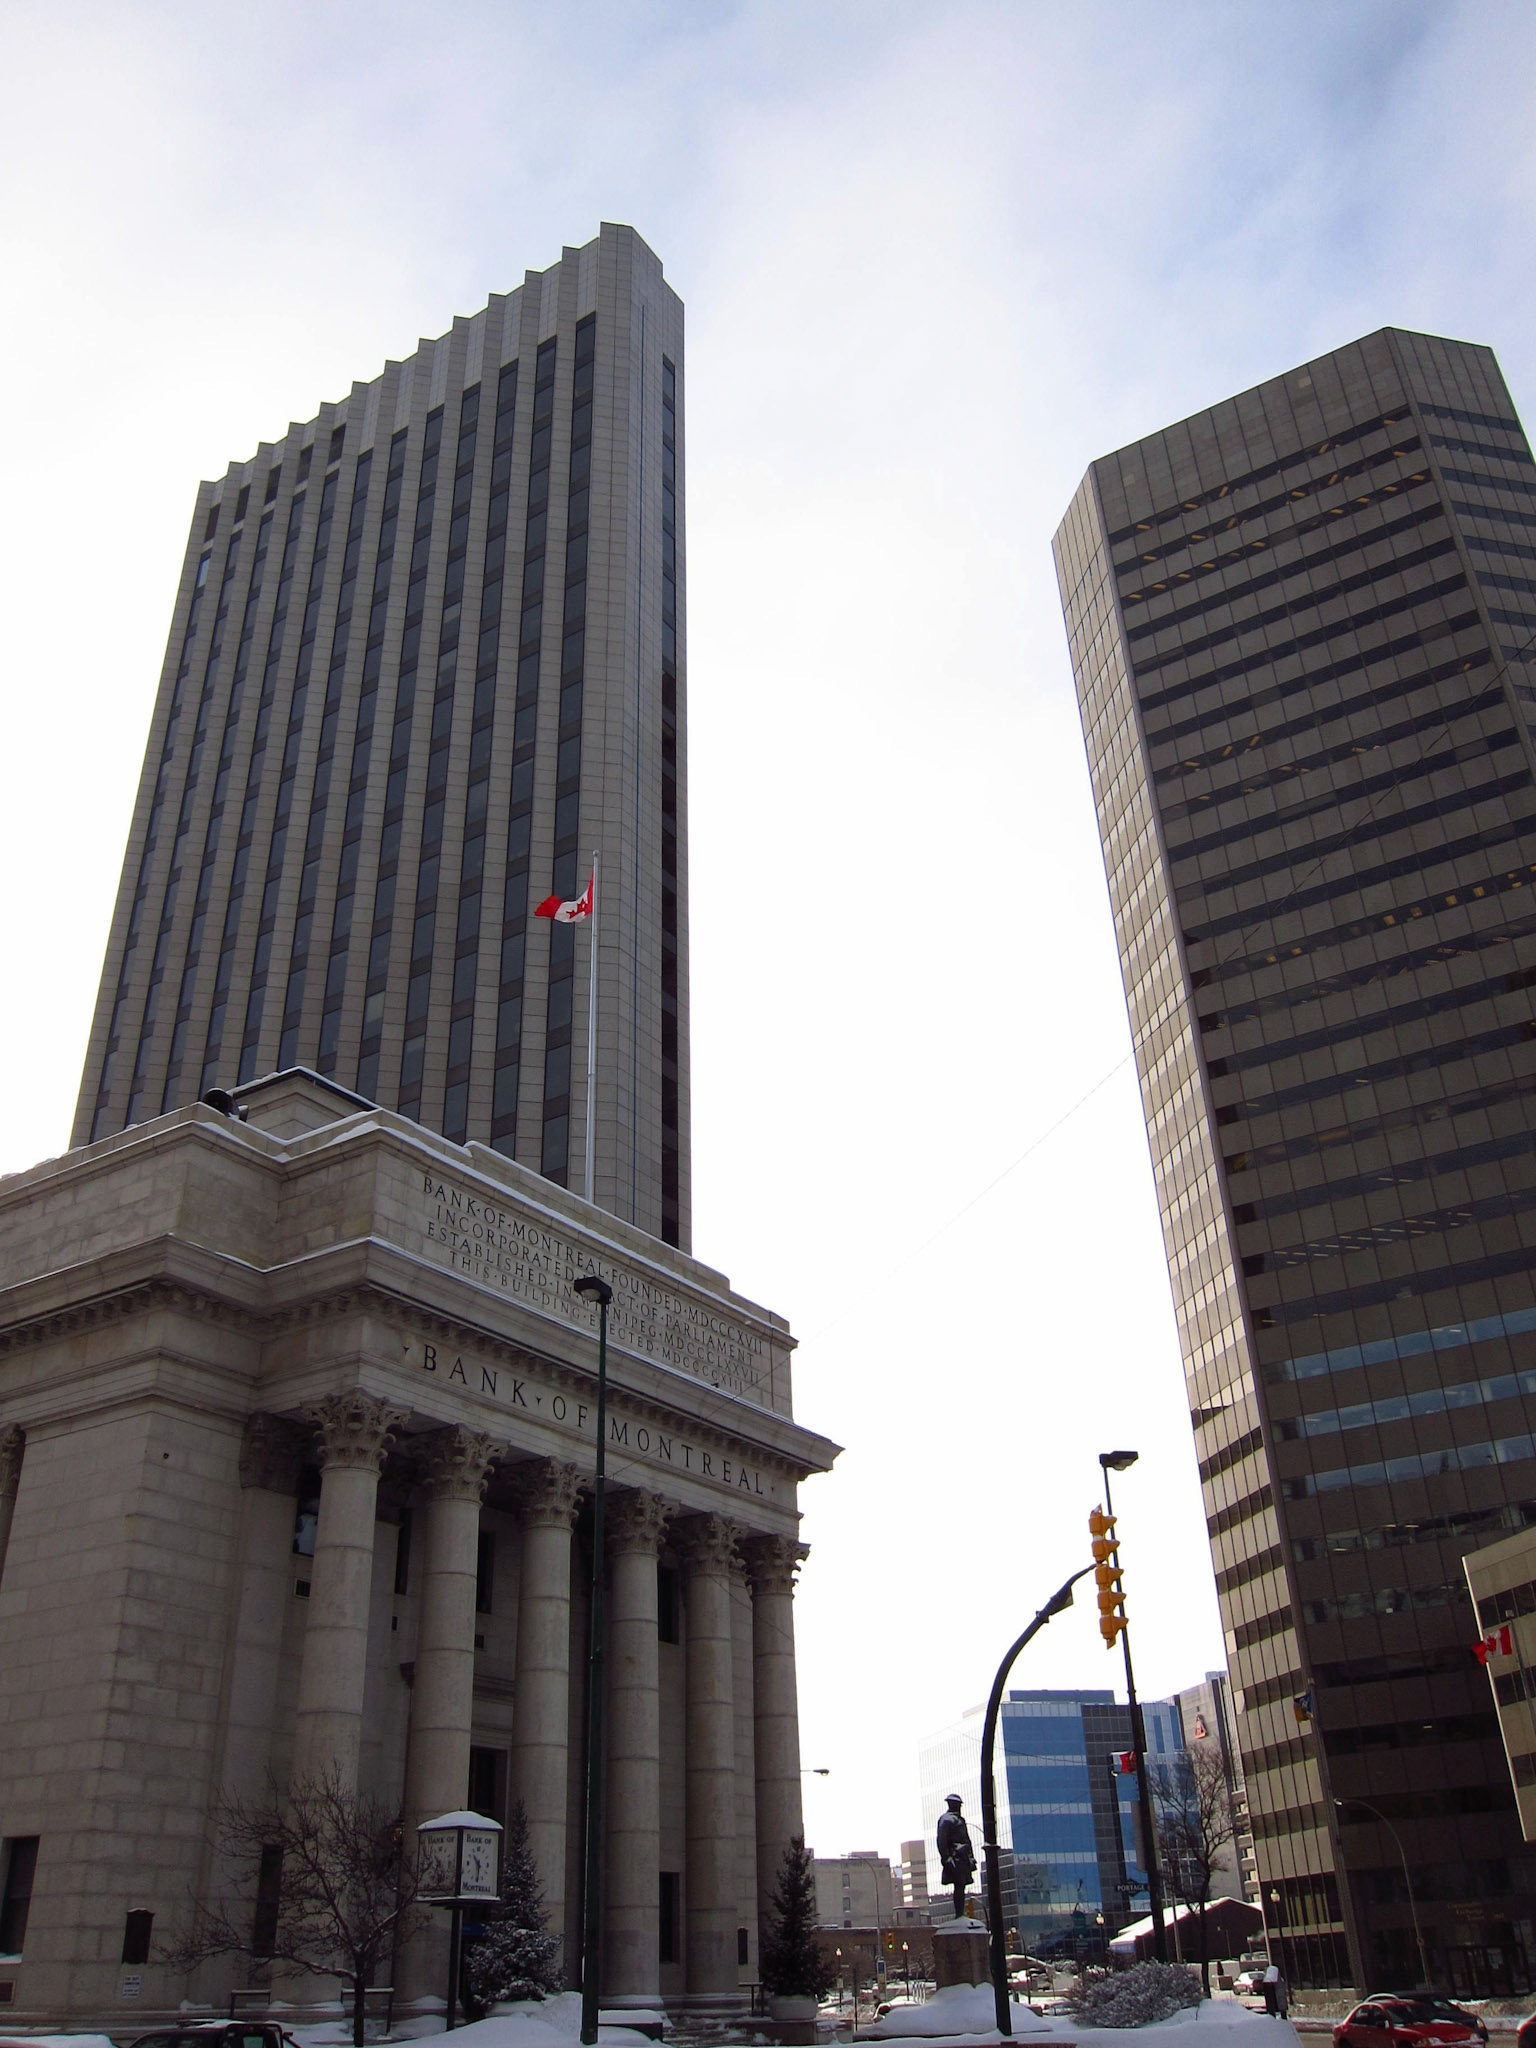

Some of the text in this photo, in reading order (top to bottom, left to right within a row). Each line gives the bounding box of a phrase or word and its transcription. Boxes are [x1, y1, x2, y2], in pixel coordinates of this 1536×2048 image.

[423, 1176, 476, 1217] BANK
[484, 1207, 506, 1228] OF
[512, 1220, 605, 1279] MONTREAL
[611, 1268, 682, 1315] FOUNDED
[688, 1306, 762, 1354] MDCCCXVII
[427, 1221, 547, 1287] ESTABLISHED
[556, 1280, 572, 1298] IN
[664, 1331, 759, 1384] MDCCCLXXVII
[437, 1205, 574, 1281] INCORPORATED
[641, 1303, 658, 1320] OF
[666, 1314, 755, 1366] PARLIAMENT
[450, 1251, 490, 1279] THIS
[501, 1274, 580, 1319] BUILDING
[590, 1314, 654, 1352] EECTED
[662, 1346, 743, 1392] MDCCCCXIII
[423, 1344, 763, 1495] BANK OF MONTREAL
